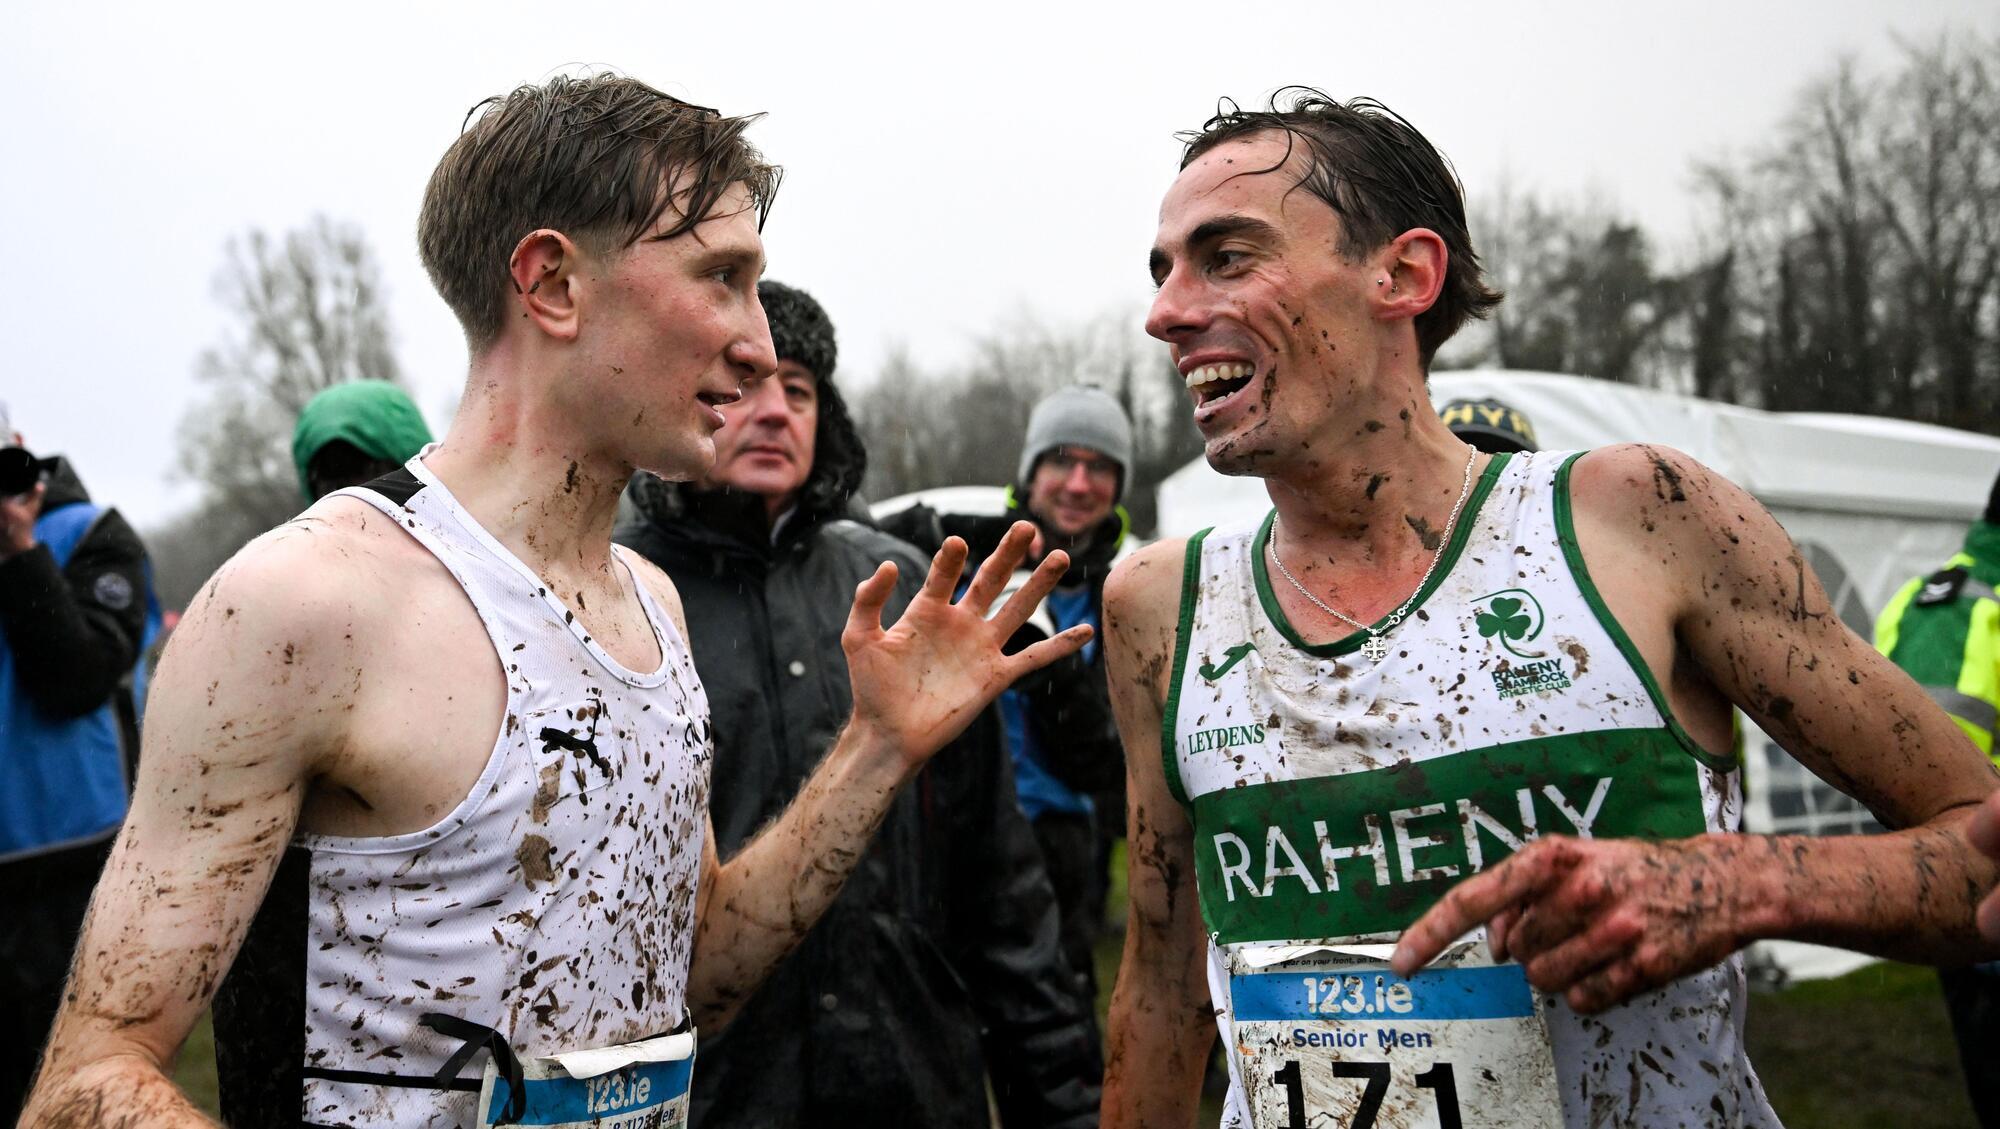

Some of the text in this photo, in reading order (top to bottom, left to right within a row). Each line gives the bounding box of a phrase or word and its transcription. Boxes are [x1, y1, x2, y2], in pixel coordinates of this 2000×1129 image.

[1491, 658, 1562, 683] RAHENY
[1545, 680, 1571, 691] CLUB
[1188, 723, 1265, 755] LEYDENS
[1213, 776, 1612, 902] RAHENY
[1303, 975, 1414, 1013] 123.ie
[1293, 1028, 1368, 1048] Senior
[1377, 1028, 1433, 1048] Men
[585, 1071, 651, 1114] 123.ie
[1274, 1060, 1464, 1129] 171
